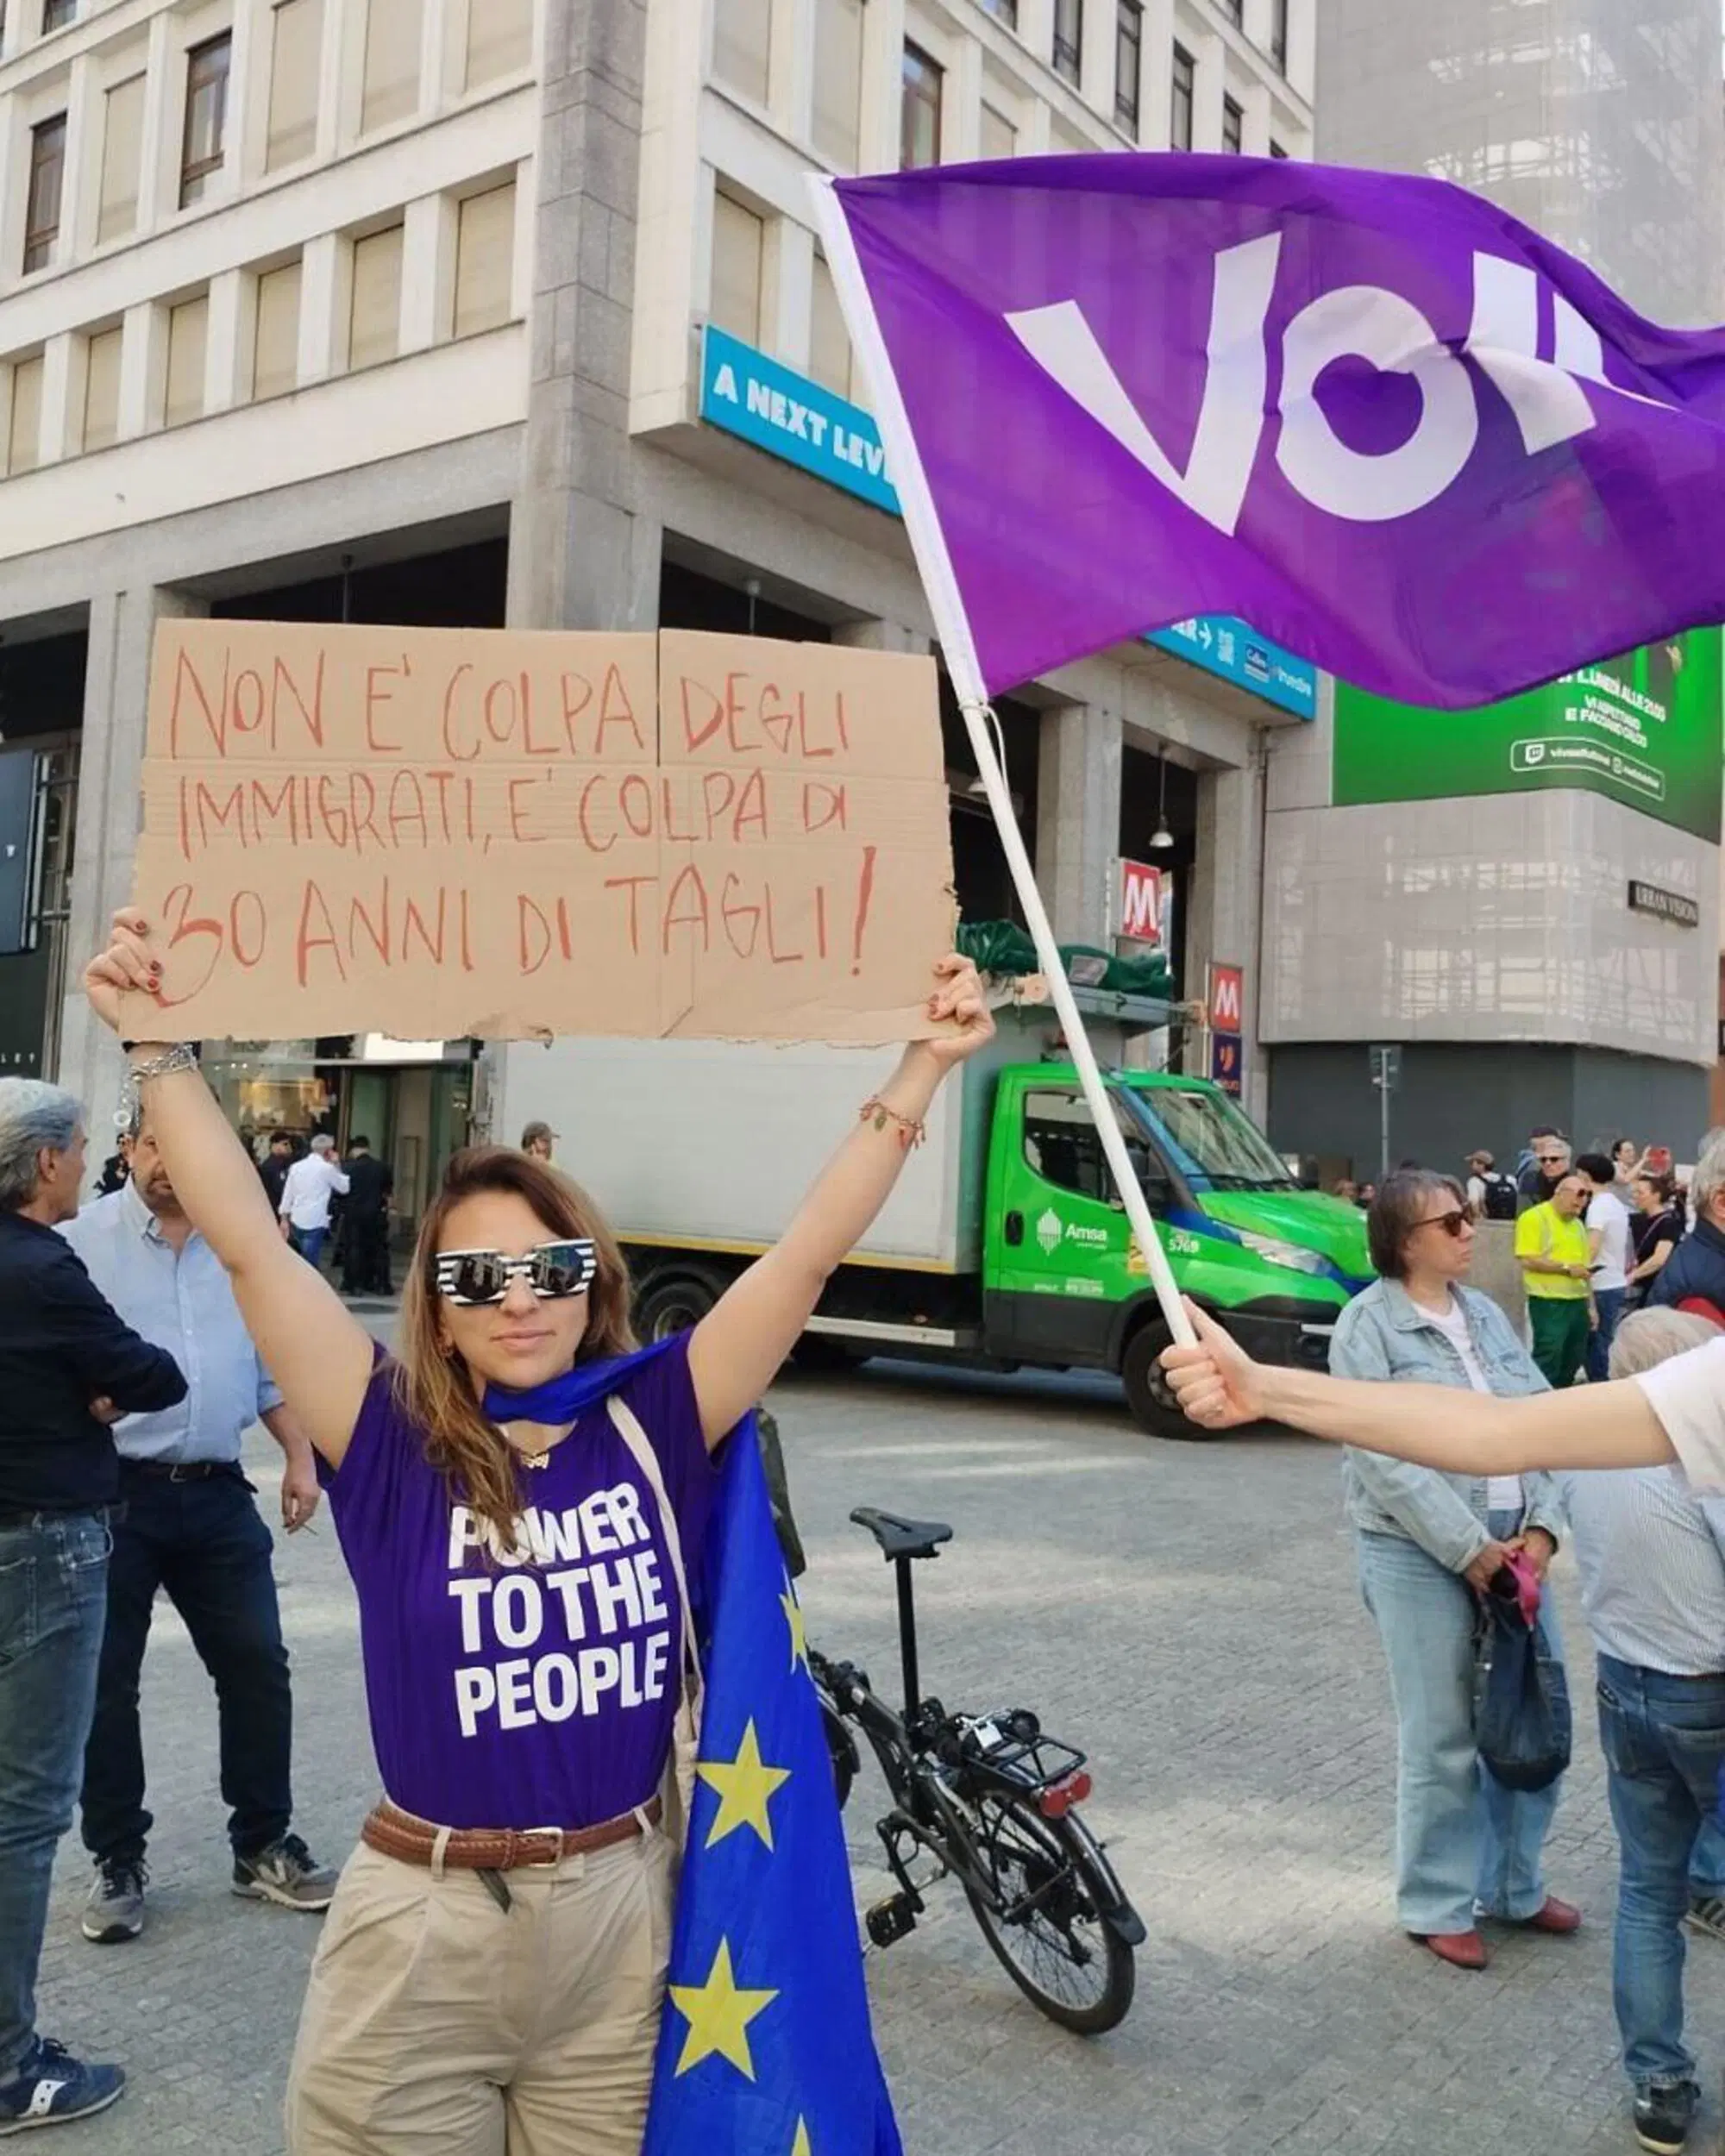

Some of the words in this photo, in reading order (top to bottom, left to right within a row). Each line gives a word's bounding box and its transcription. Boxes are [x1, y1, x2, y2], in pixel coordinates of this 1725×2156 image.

[712, 363, 738, 404] A
[747, 378, 828, 447] NEXT
[832, 424, 895, 486] LEV
[170, 646, 326, 761] NON
[366, 652, 411, 750] E'
[442, 662, 645, 761] COLPA
[680, 671, 849, 758] DEGLI
[179, 768, 493, 862] IMMIGRATI,
[508, 768, 553, 843] E'
[579, 767, 768, 853] COLPA
[802, 781, 845, 833] DI
[150, 883, 267, 1007] 30
[296, 874, 474, 988] ANNI
[518, 894, 571, 976] DI
[604, 845, 877, 977] TAGLI!
[1124, 874, 1157, 935] M
[1214, 979, 1239, 1019] M
[1065, 1223, 1107, 1241] Amsa
[448, 1482, 650, 1569] POWER
[448, 1574, 543, 1653] TO
[546, 1550, 668, 1641] THE
[454, 1631, 670, 1738] PEOPLE
